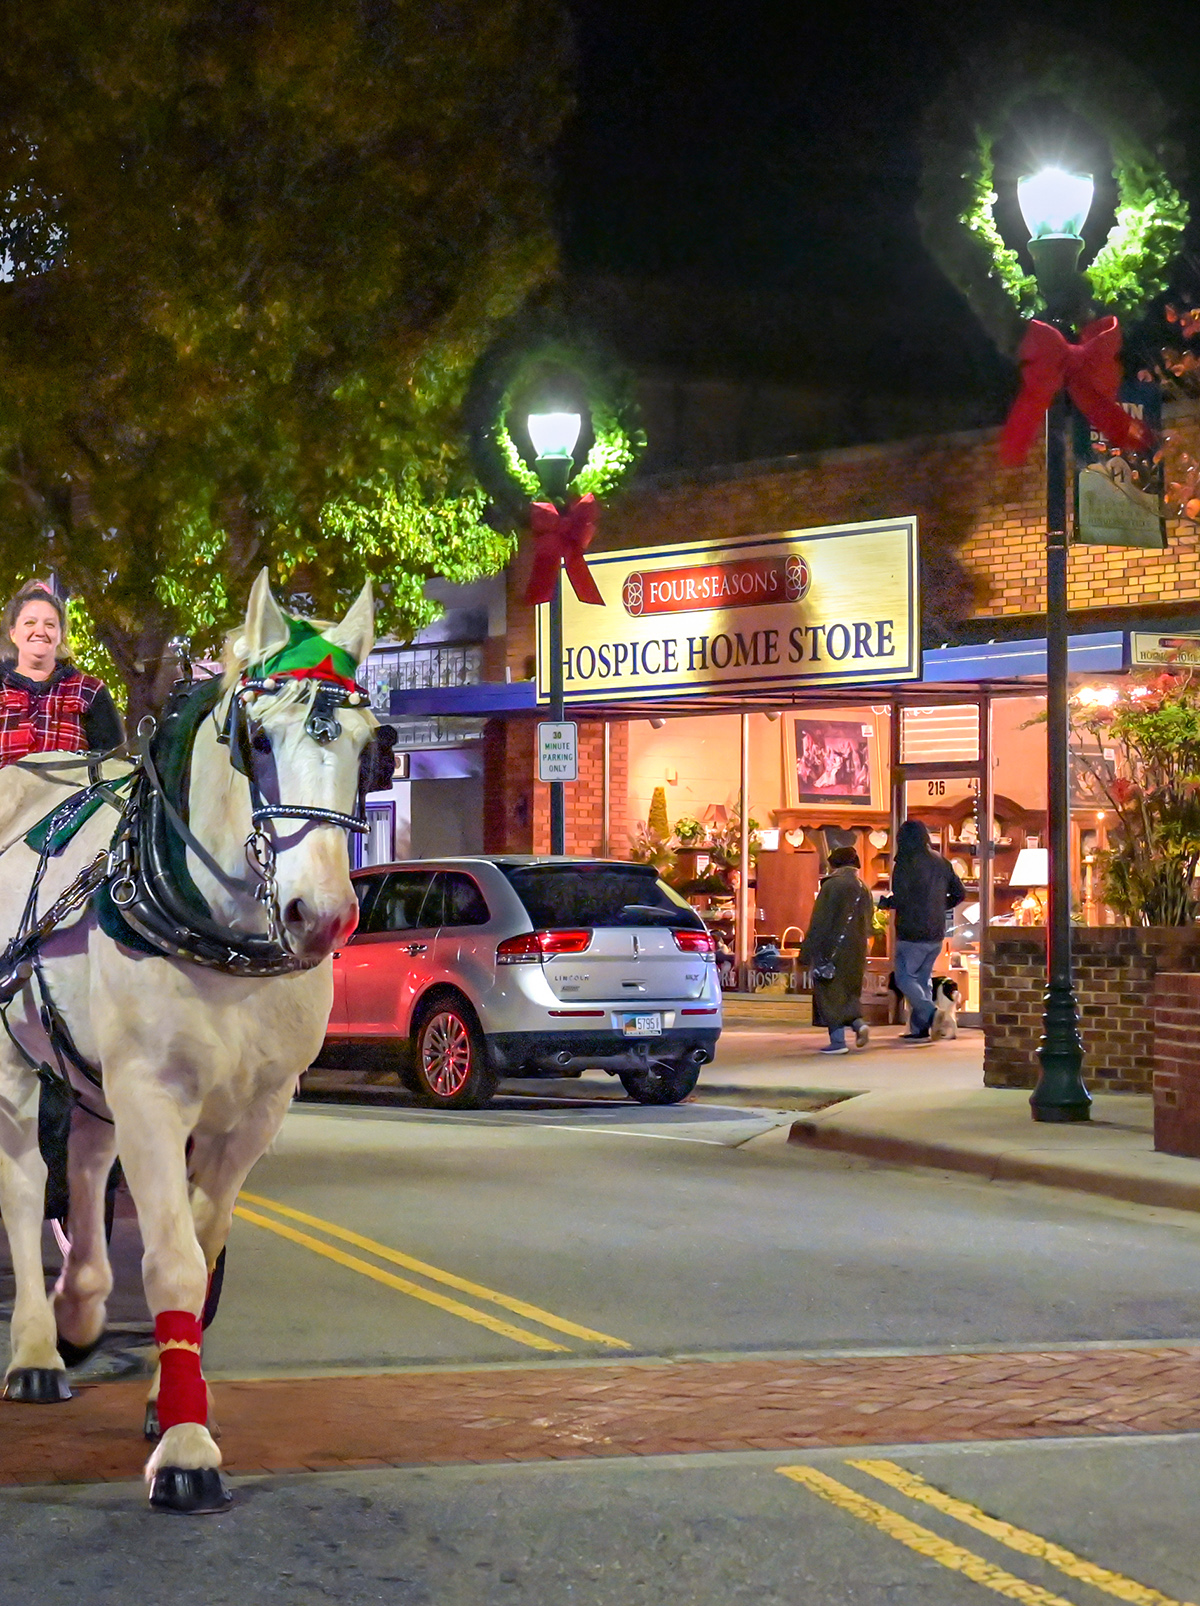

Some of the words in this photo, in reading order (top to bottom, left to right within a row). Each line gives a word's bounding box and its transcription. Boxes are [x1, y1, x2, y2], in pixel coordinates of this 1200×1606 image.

[563, 638, 679, 680] HOSPICE
[686, 629, 780, 671] HOME
[788, 619, 896, 663] STORE
[553, 731, 562, 739] 30
[928, 780, 945, 796] 215
